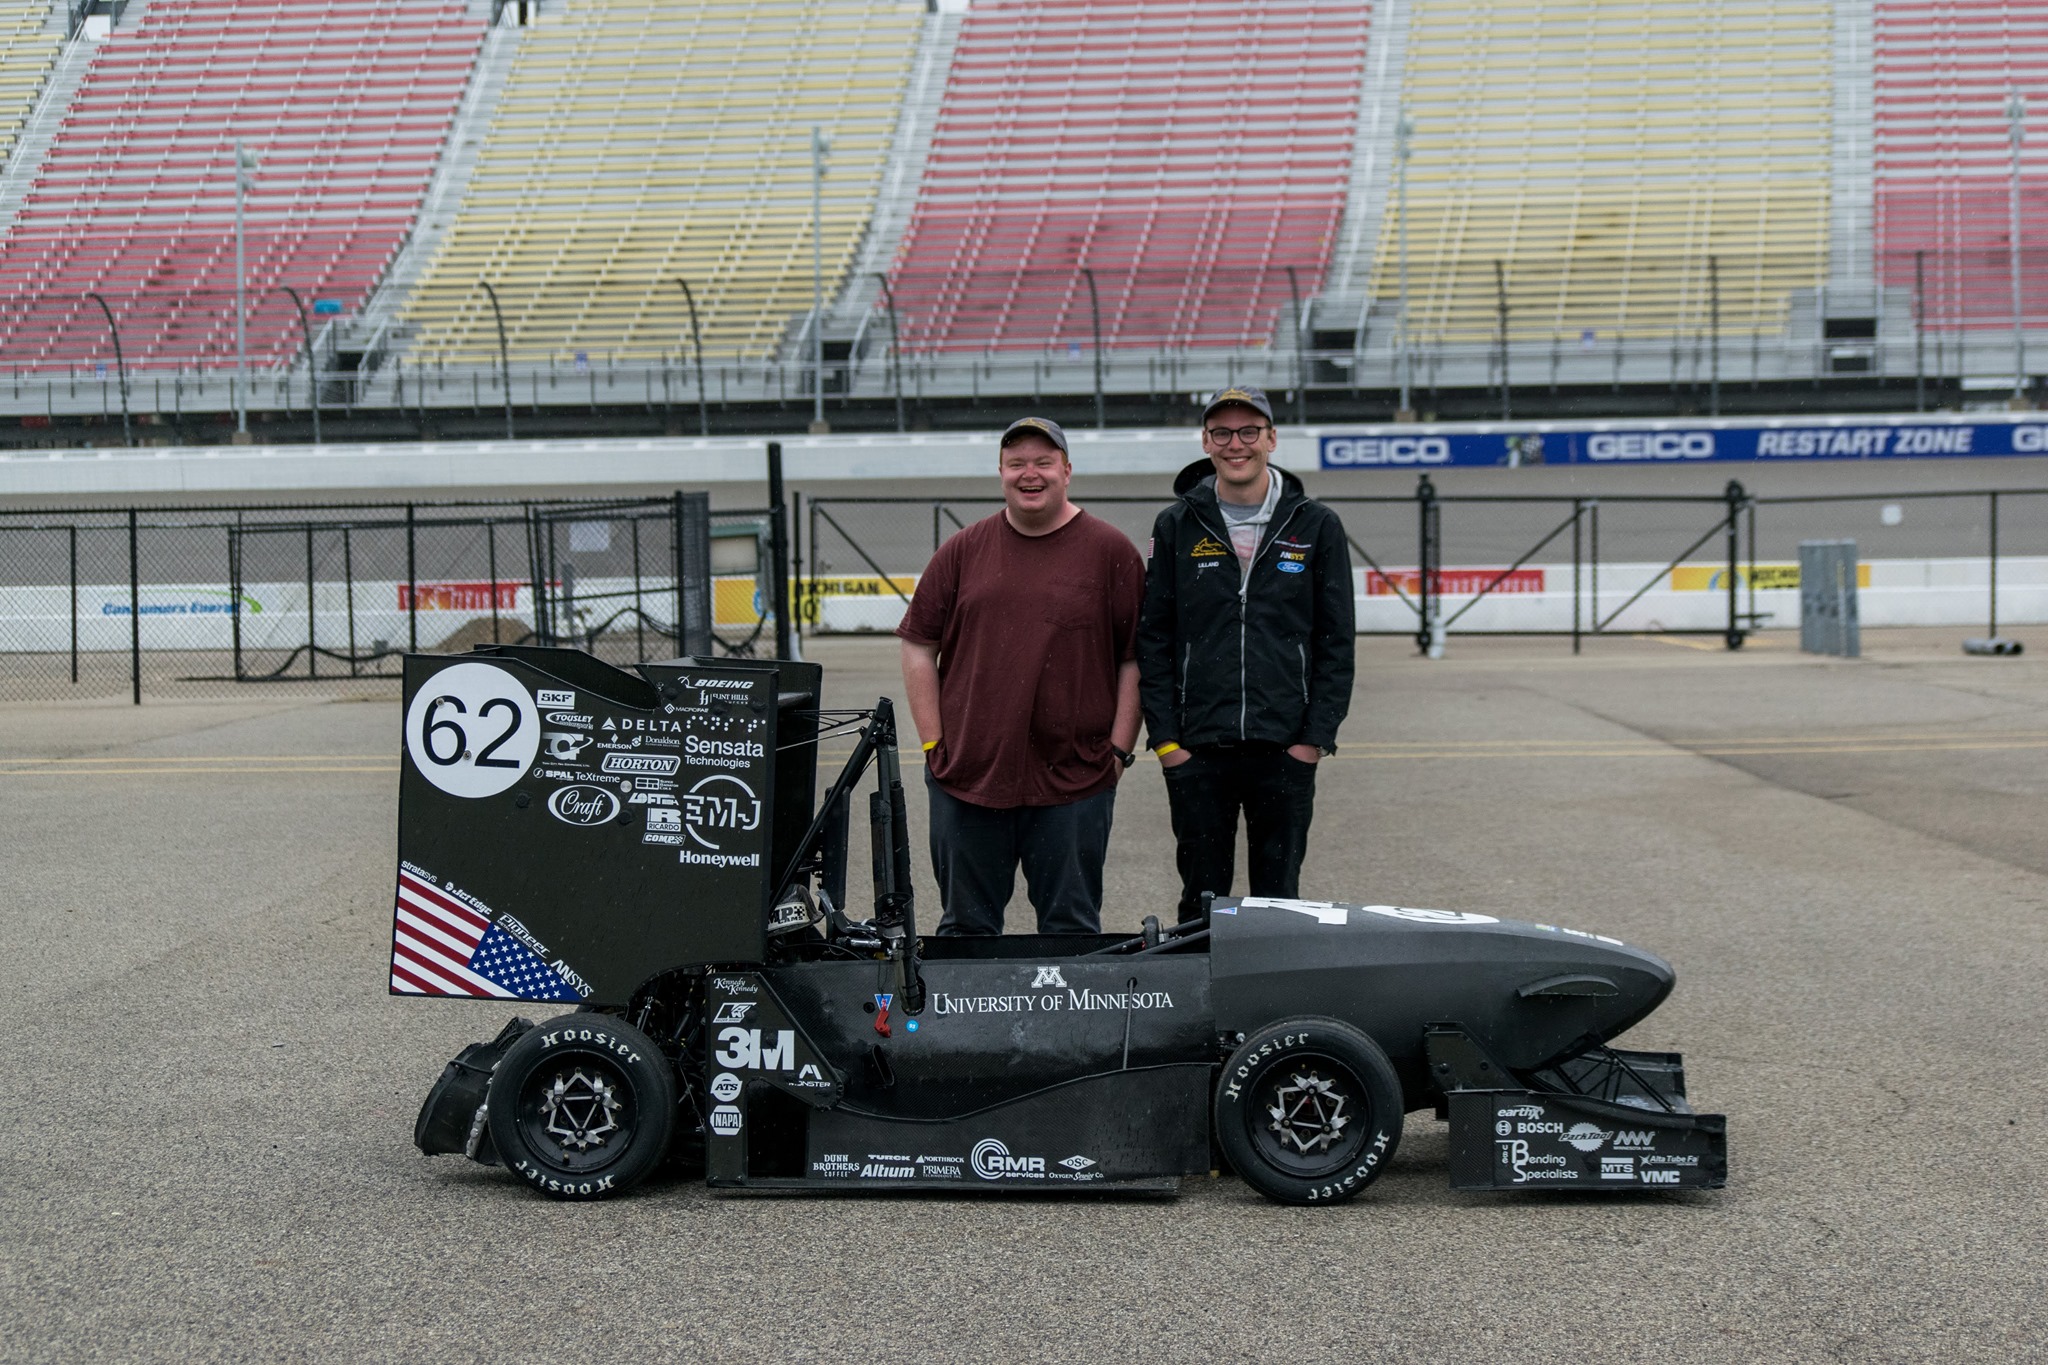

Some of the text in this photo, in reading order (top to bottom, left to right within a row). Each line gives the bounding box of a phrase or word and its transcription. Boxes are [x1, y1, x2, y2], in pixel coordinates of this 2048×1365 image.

[1586, 432, 1715, 460] GEICO
[1757, 427, 1975, 457] RESTART ZONE
[1325, 438, 1450, 465] GEICO
[102, 602, 186, 615] Conumers
[694, 679, 754, 689] BOEING
[541, 693, 572, 703] SKF
[555, 714, 594, 723] TOUSLEY
[422, 694, 522, 769] 62
[622, 718, 682, 733] DELTA
[597, 742, 632, 750] EMERSON
[685, 734, 764, 757] Sensata
[608, 757, 674, 771] HORTON
[684, 754, 751, 770] Technologies
[545, 770, 574, 779] SPAL
[575, 771, 620, 783] TeXtreme
[560, 789, 606, 823] Craft
[683, 794, 761, 831] EMJ
[648, 823, 680, 831] RICARDO
[644, 834, 675, 843] COMP
[680, 850, 760, 868] Honeywell
[401, 860, 438, 883] stratasys
[551, 959, 594, 998] ANSYS
[713, 977, 746, 989] Kennedy
[728, 984, 758, 996] Kennedy
[1041, 995, 1063, 1011] OF
[541, 1029, 641, 1063] Hoosier
[715, 1026, 795, 1071] 3M
[1225, 1032, 1309, 1102] Hoosier
[715, 1083, 738, 1091] ATS
[715, 1113, 739, 1127] NAPA
[1517, 1122, 1564, 1134] BOSCH
[824, 1154, 849, 1162] DUNN
[988, 1156, 1045, 1171] RMR
[1066, 1158, 1089, 1168] OSC
[812, 1162, 860, 1172] BROTHERS
[923, 1165, 962, 1175] PRIMERA
[1601, 1164, 1633, 1173] MTS
[1640, 1170, 1681, 1183] VMC
